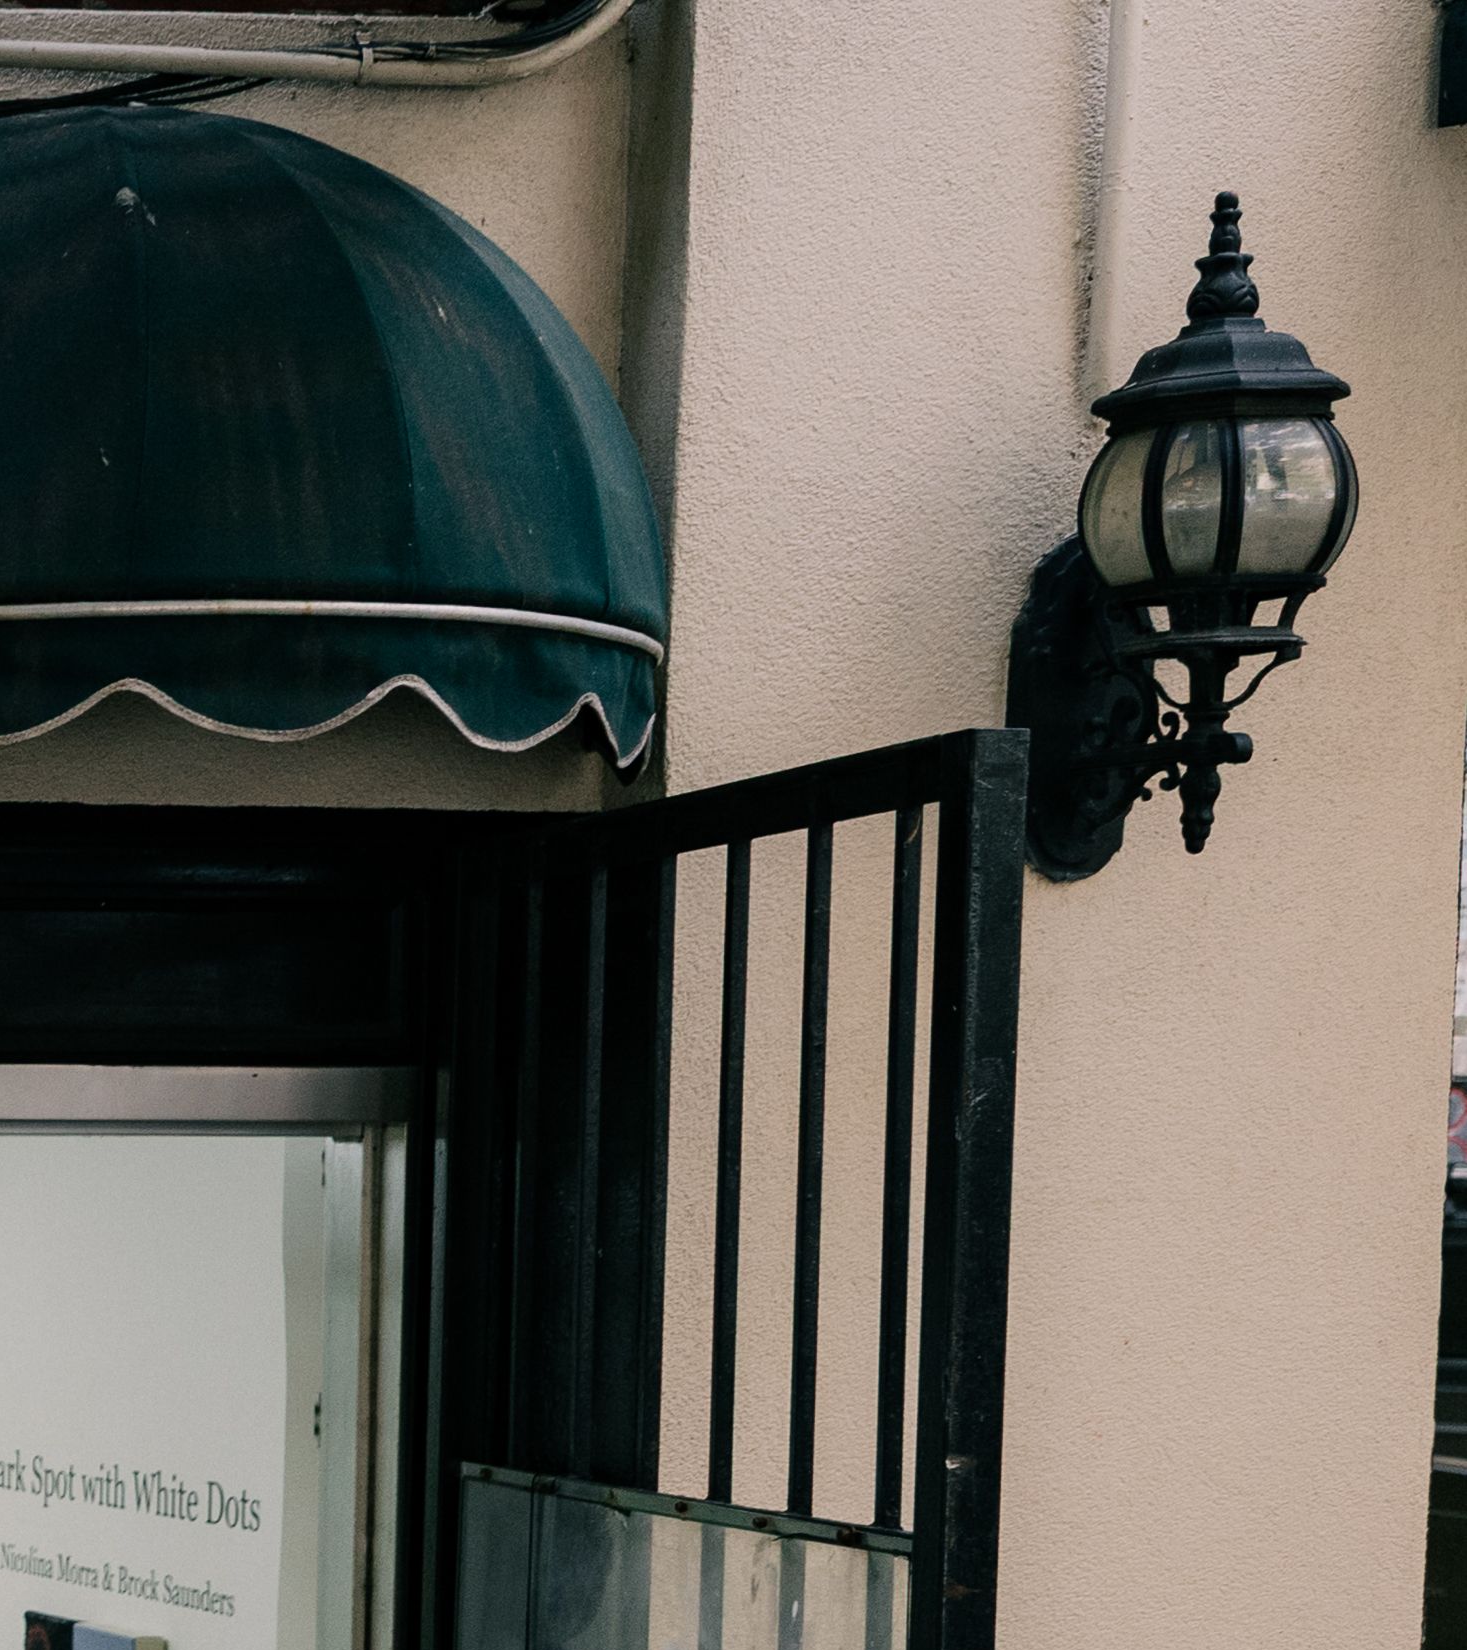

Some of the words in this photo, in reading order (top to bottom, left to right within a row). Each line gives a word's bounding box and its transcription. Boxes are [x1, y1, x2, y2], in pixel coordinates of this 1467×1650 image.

[31, 1454, 76, 1507] Spot
[82, 1463, 126, 1510] with
[133, 1470, 198, 1522] White
[206, 1480, 262, 1532] Dots
[0, 1542, 52, 1579] Nicolina
[56, 1553, 98, 1588] Morra
[101, 1562, 115, 1592] &
[118, 1565, 160, 1602] Brock
[163, 1574, 236, 1618] Saunders
